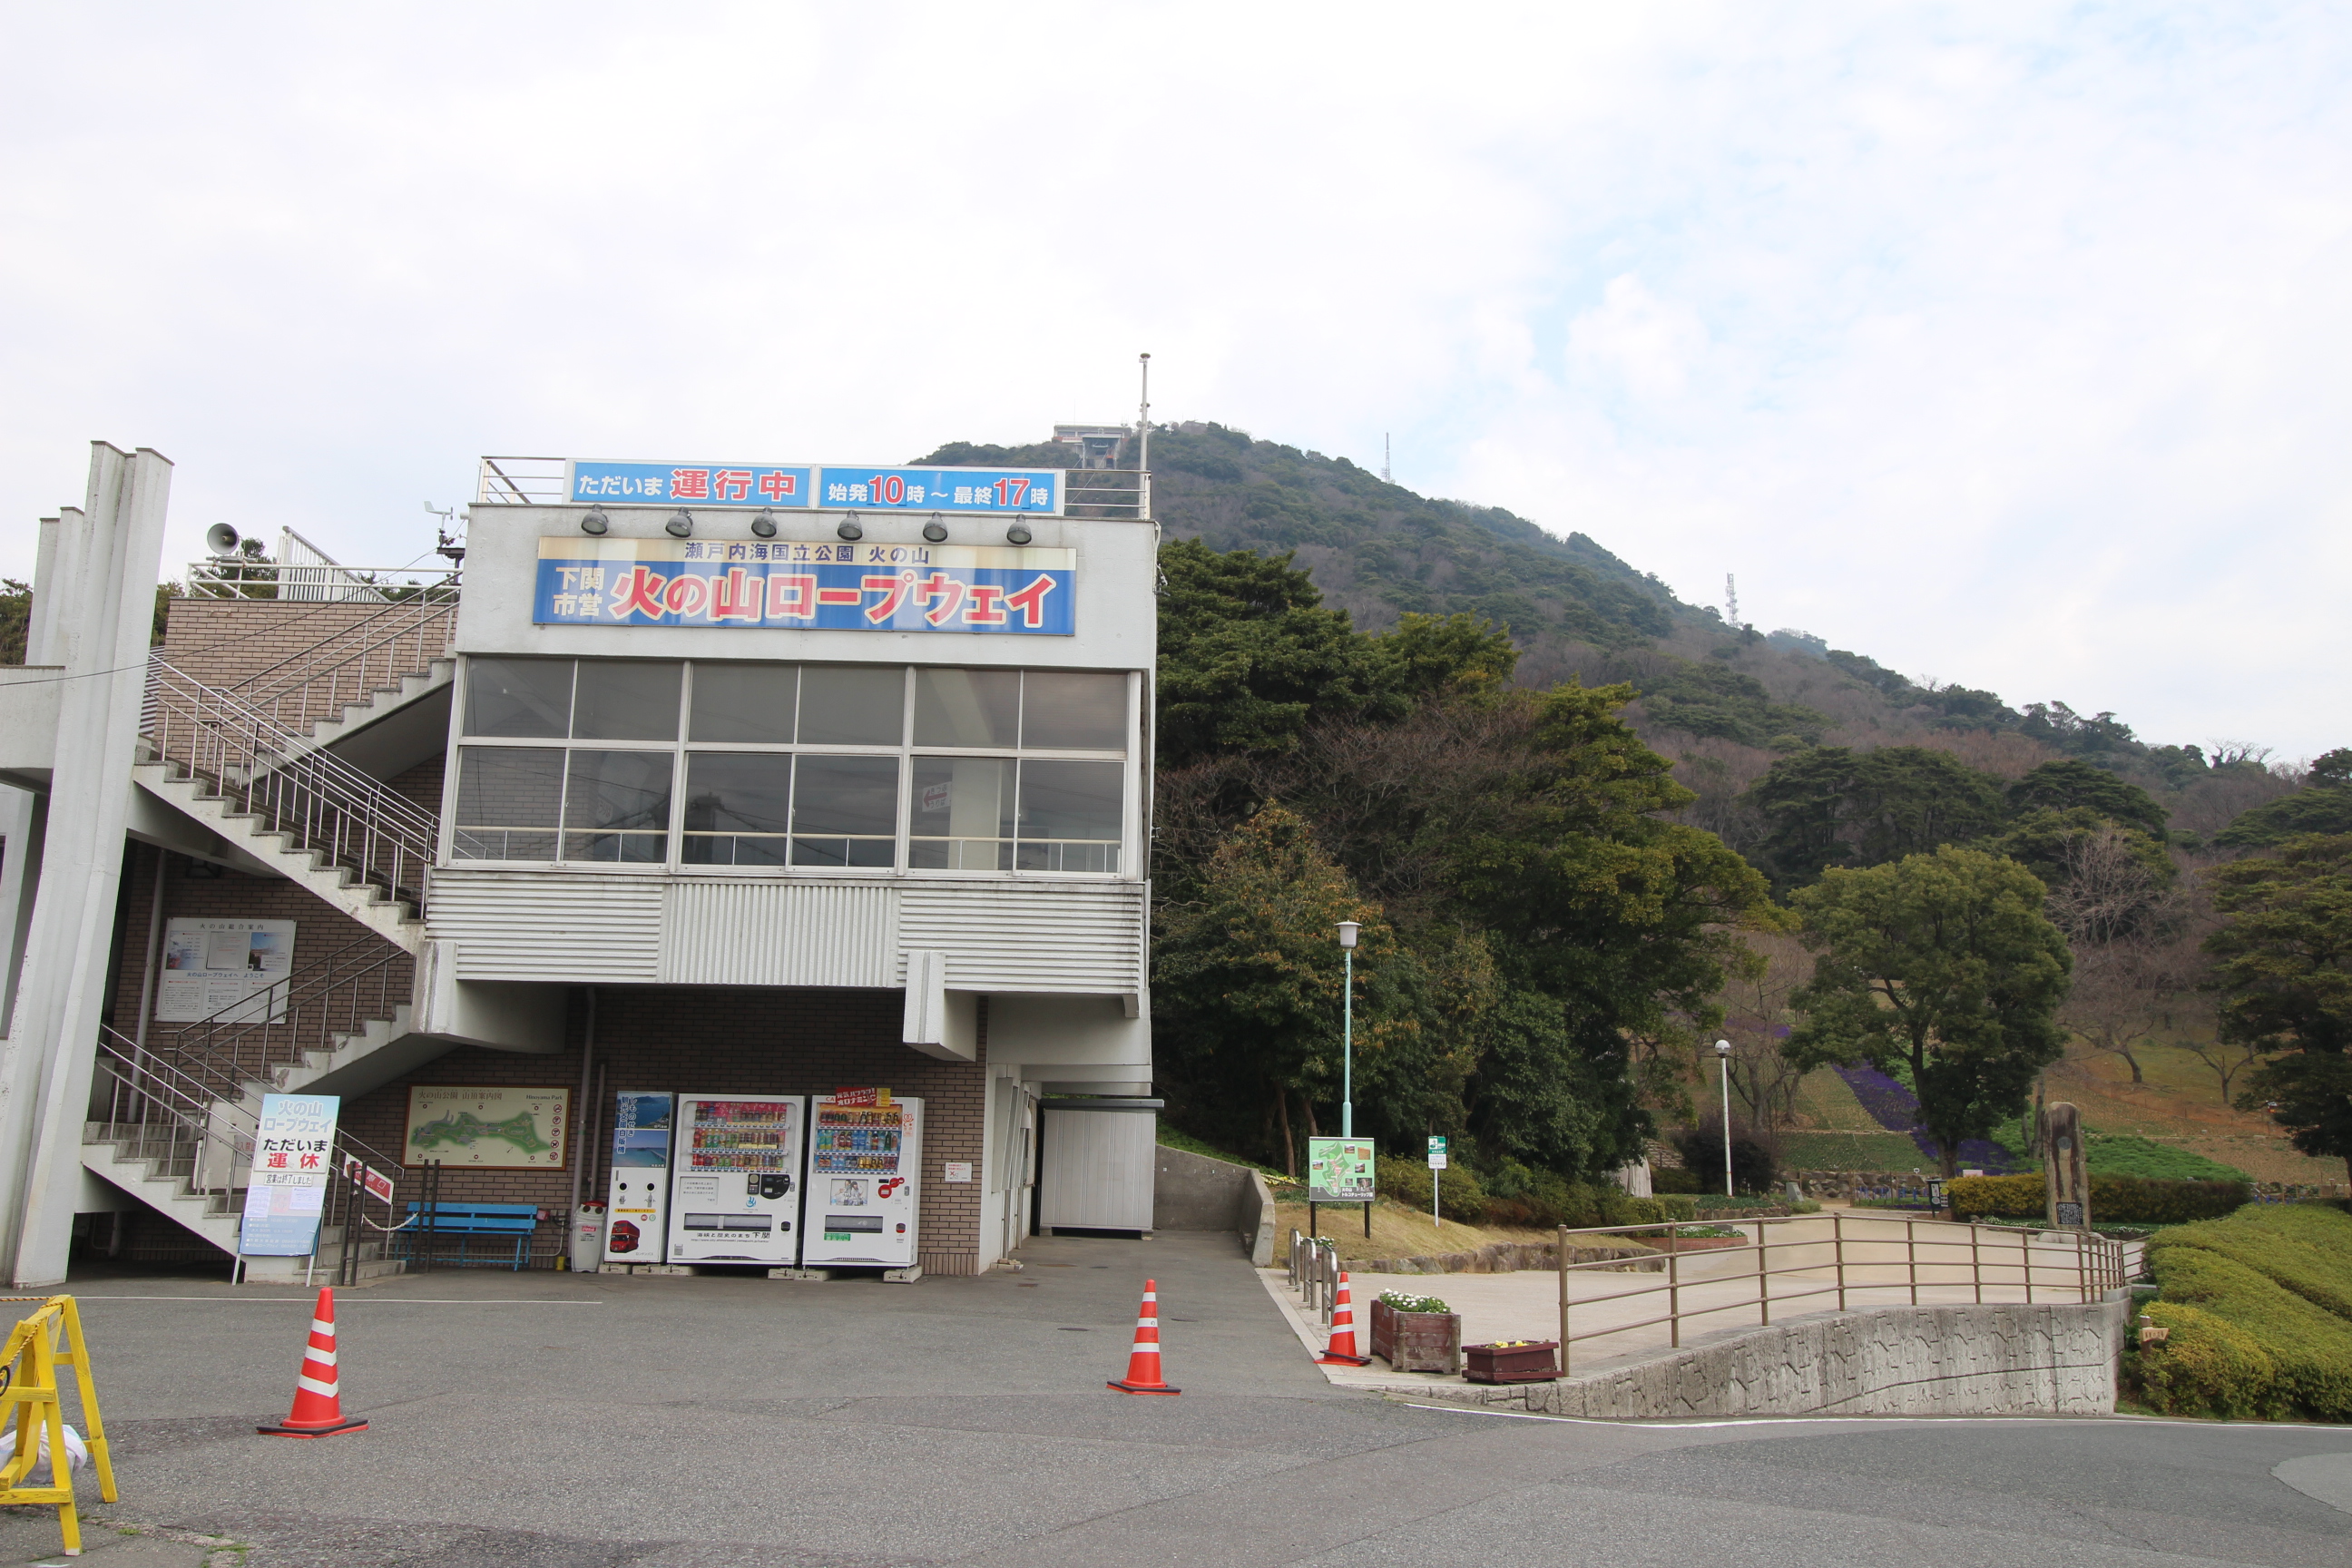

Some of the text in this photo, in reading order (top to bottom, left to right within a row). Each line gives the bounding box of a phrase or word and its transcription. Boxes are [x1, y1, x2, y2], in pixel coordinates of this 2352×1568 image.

[579, 468, 796, 502] ただいま 運行中
[828, 475, 925, 505] 始発10時
[954, 477, 1049, 506] 最終17時
[684, 542, 929, 564] 瀬戸内海国立公園 火の山
[555, 566, 605, 591] 下関
[553, 593, 603, 617] 市営
[608, 565, 1056, 628] 火の山ロープウェイ
[278, 1100, 323, 1117] 火の山
[263, 1117, 333, 1133] ロープウェイ
[263, 1138, 328, 1152] ただいま
[266, 1174, 311, 1184] 営業は終了しました
